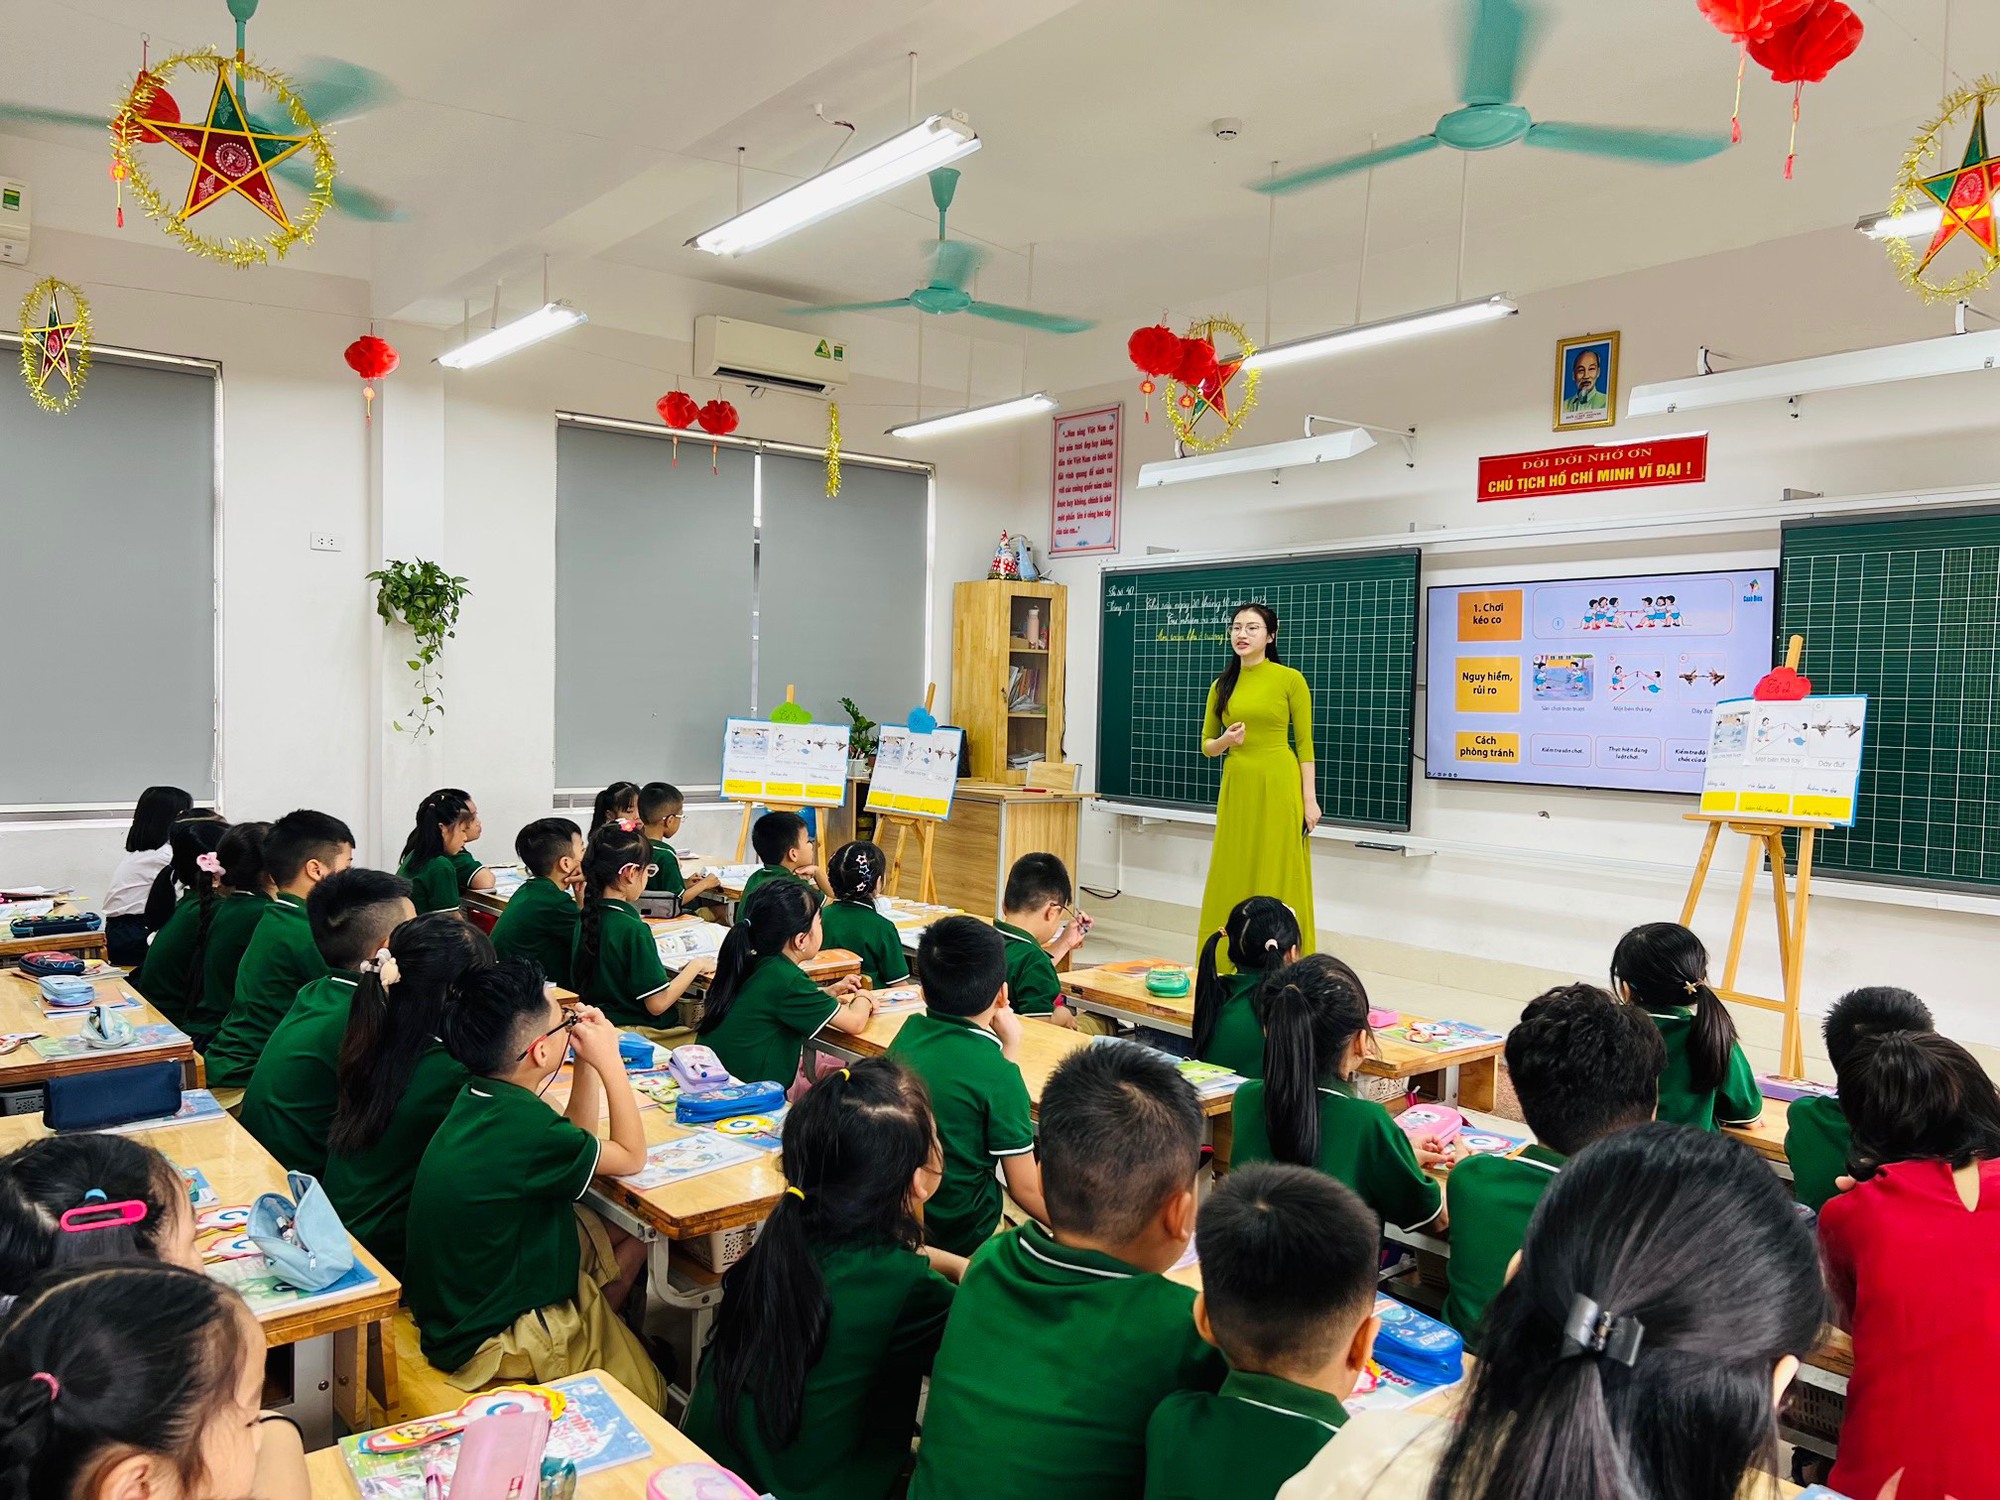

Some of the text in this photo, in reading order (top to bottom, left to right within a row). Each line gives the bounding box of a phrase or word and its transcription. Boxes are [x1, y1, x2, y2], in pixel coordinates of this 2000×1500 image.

[1522, 448, 1653, 470] ĐỜI ĐỜI NHỚ ƠN
[1488, 461, 1692, 493] CHỦ TỊCH HỒ CHÍ MINH VĨ ĐẠI !
[1473, 602, 1504, 613] 1. Chơi
[1473, 616, 1489, 625] kéo
[1462, 670, 1513, 683] Nguy hiểm,
[1473, 685, 1485, 694] rủi
[1475, 735, 1497, 745] Cách
[1460, 747, 1515, 758] phòng tránh
